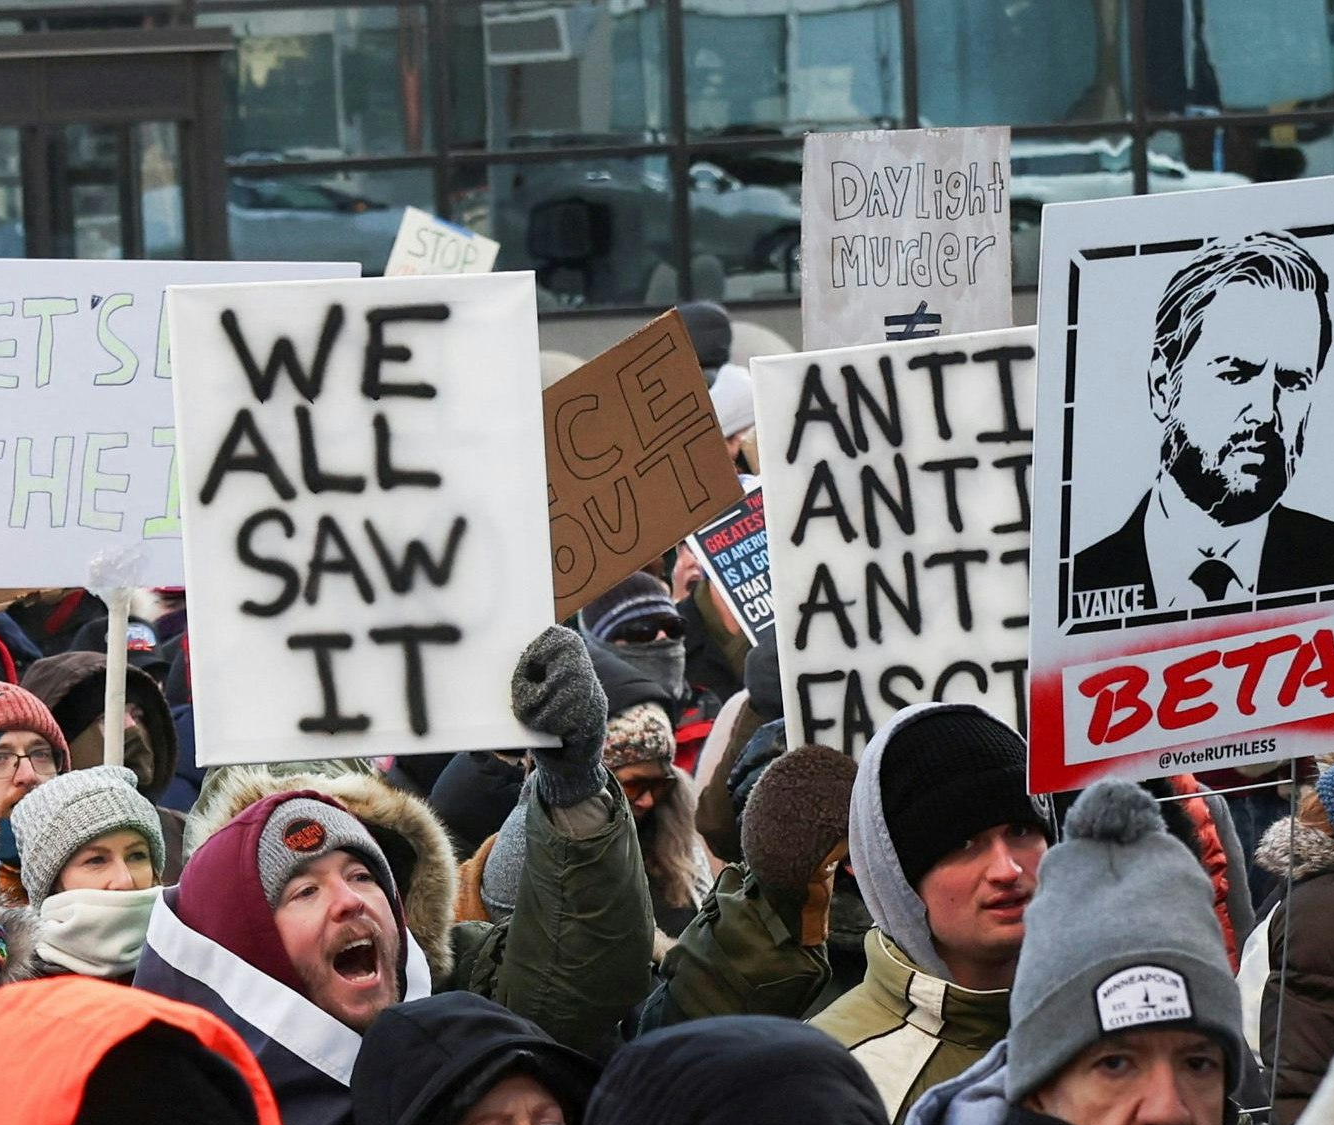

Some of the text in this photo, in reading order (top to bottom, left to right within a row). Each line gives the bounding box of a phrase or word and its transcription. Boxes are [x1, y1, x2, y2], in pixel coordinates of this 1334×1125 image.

[220, 303, 450, 403] WE
[549, 333, 698, 506] CE
[786, 346, 1034, 464] ANTI
[199, 405, 442, 504] ALL
[791, 455, 1031, 548] ANTI
[553, 412, 715, 600] OUT
[237, 507, 467, 617] SAW
[713, 552, 732, 569] TO
[722, 568, 740, 587] IS
[739, 561, 754, 579] A
[732, 573, 768, 603] THAT
[1074, 583, 1145, 619] VANCE
[287, 625, 462, 736] IT
[1158, 738, 1277, 769] @VoteRUTHLESS
[1109, 1014, 1133, 1026] CITY
